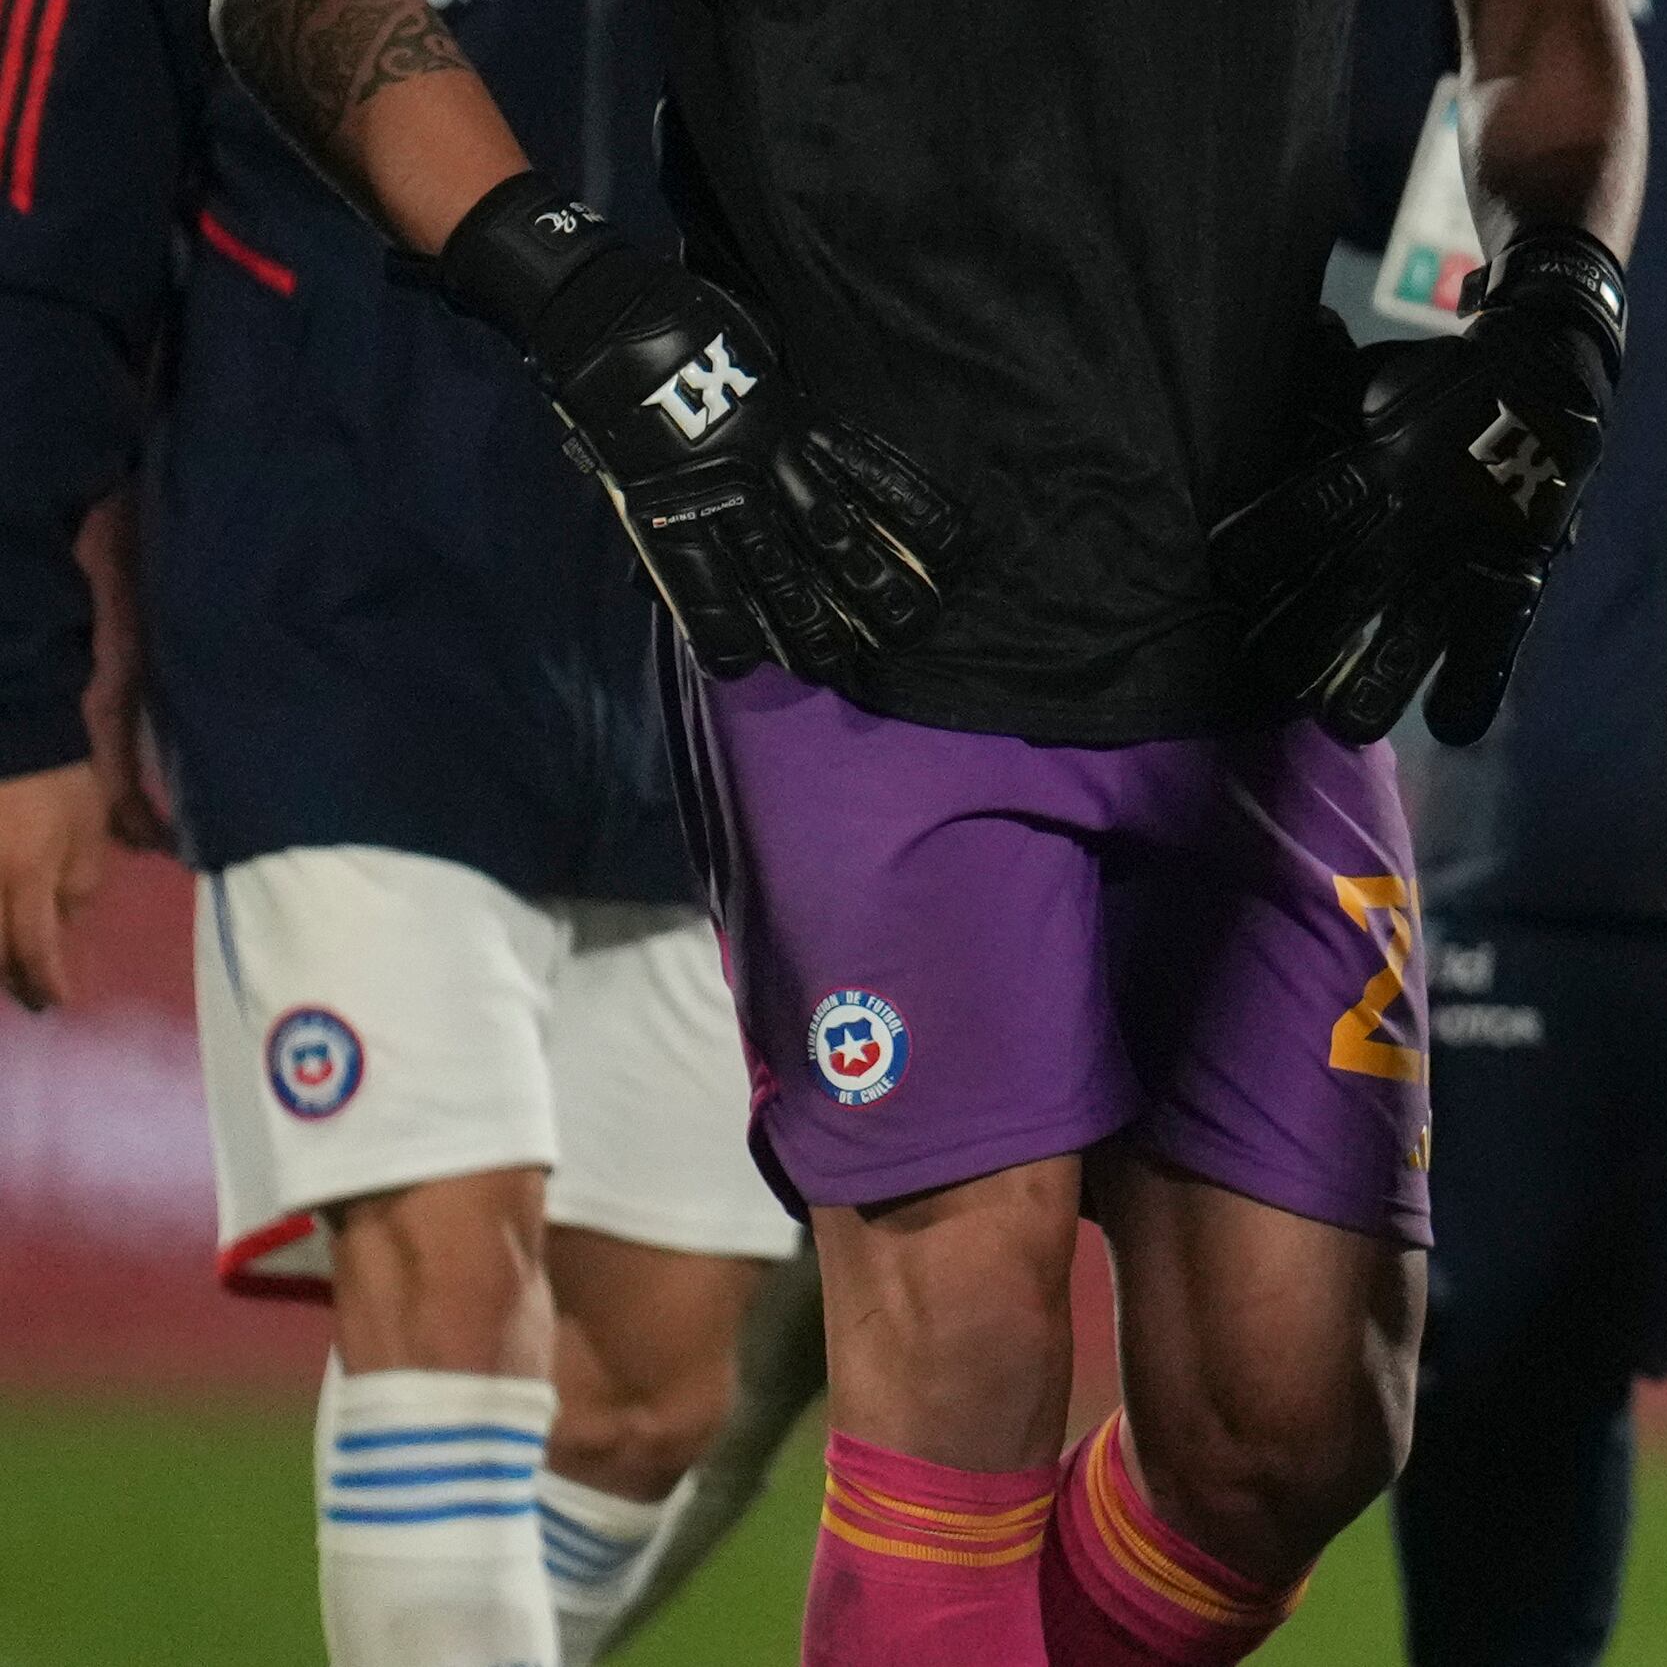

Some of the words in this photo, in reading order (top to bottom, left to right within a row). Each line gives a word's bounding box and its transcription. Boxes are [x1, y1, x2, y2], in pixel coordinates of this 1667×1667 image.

[667, 511, 697, 524] GRIP
[845, 990, 863, 1005] DE
[866, 994, 904, 1038] FUTBOL
[838, 1090, 854, 1105] DE
[860, 1075, 895, 1104] CHILE
